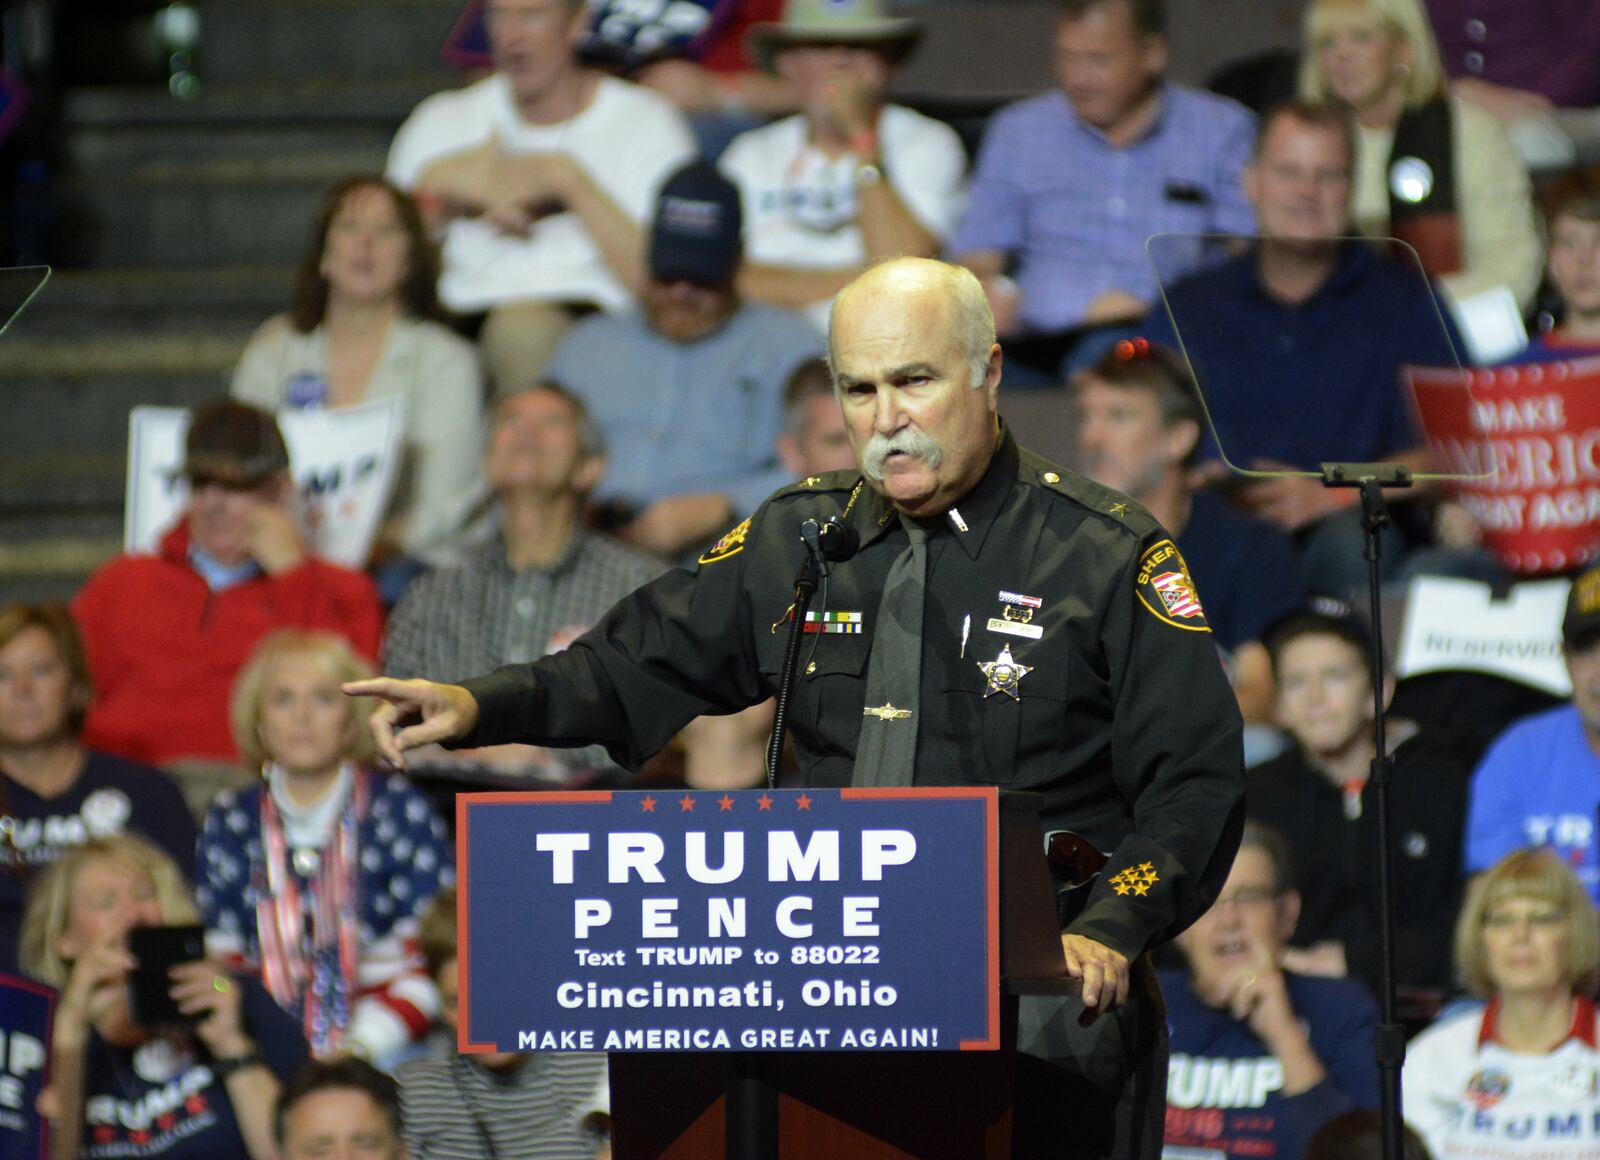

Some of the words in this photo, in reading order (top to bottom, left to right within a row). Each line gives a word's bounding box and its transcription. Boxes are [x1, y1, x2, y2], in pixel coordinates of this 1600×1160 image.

[1470, 396, 1566, 430] MAKE
[535, 830, 917, 884] TRUMP
[574, 895, 880, 940] PENCE
[575, 948, 626, 967] Text
[636, 946, 743, 966] TRUMP
[753, 948, 780, 965] to
[790, 945, 881, 965] 88022
[556, 979, 786, 1012] Cincinnati,
[801, 979, 898, 1007] Ohio
[518, 1030, 595, 1050] MAKE
[603, 1029, 731, 1050] AMERICA
[740, 1028, 831, 1048] GREAT
[840, 1028, 938, 1048] AGAIN!
